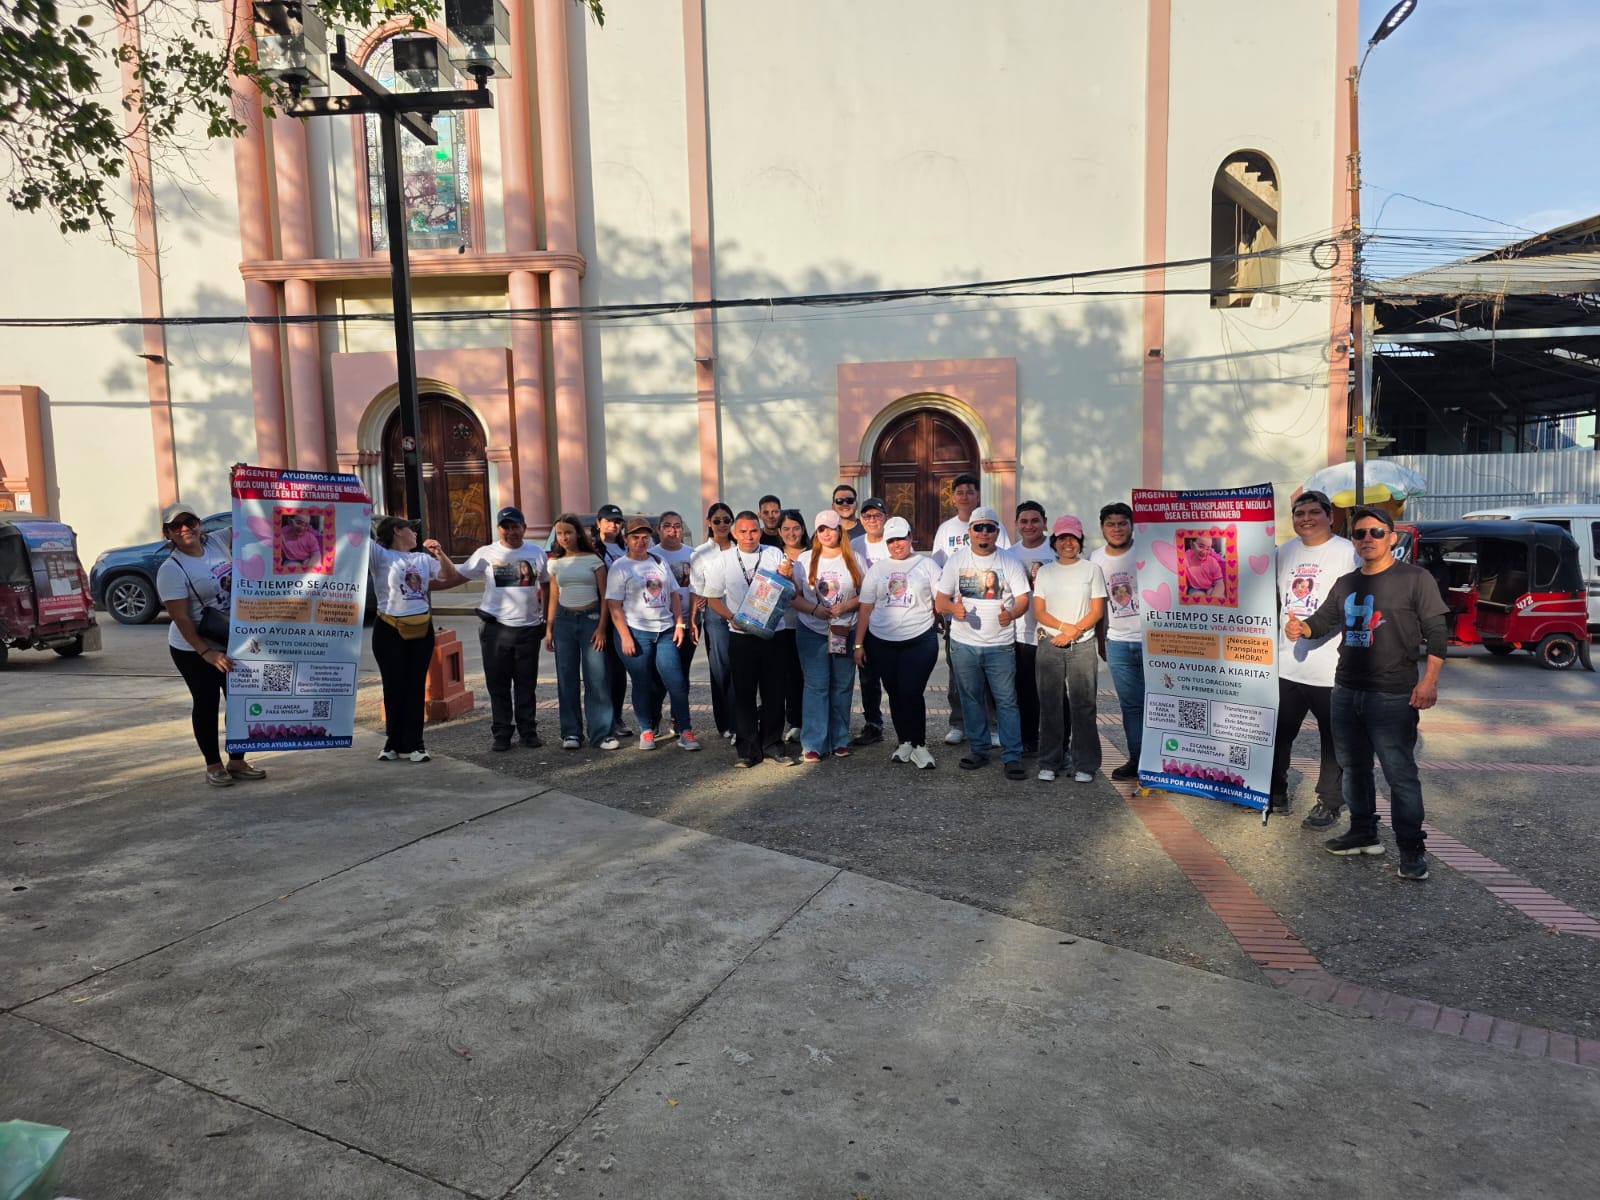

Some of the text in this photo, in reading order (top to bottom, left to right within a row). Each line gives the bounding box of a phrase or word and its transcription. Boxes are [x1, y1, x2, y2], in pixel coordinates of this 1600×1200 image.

[282, 472, 328, 481] AYUDEMOS
[281, 490, 290, 498] EN
[291, 490, 299, 498] EL
[1238, 487, 1272, 496] KIARITA
[1154, 502, 1170, 512] CURA
[1171, 502, 1189, 511] REAL:
[1190, 501, 1234, 510] TRANSPLANTE
[1236, 501, 1244, 510] DE
[1246, 500, 1272, 510] MEDULA
[1182, 510, 1191, 520] EN
[1192, 510, 1200, 519] EL
[1200, 510, 1241, 519] EXTRANJERO
[257, 580, 304, 589] TIEMPO
[308, 580, 320, 589] SE
[322, 582, 360, 592] AGOTA!
[1516, 596, 1534, 610] 472
[1146, 610, 1272, 626] ¡EL TIEMPO SE AGOTA!
[270, 627, 306, 636] AYUDAR
[309, 628, 315, 636] A
[318, 630, 354, 638] KIARITA?
[1164, 622, 1188, 630] AYUDA
[1236, 626, 1266, 634] MUERTE
[1228, 637, 1260, 646] ¡Necesita
[1348, 632, 1368, 642] PRO
[1226, 644, 1269, 654] Transplante
[1234, 653, 1262, 662] AHORA!
[1148, 660, 1270, 680] COMO AYUDAR A KIARITA?
[1205, 678, 1242, 688] ORACIONES
[1170, 778, 1184, 786] POR
[1185, 780, 1213, 790] AYUDAR
[1220, 787, 1243, 798] SALVAR
